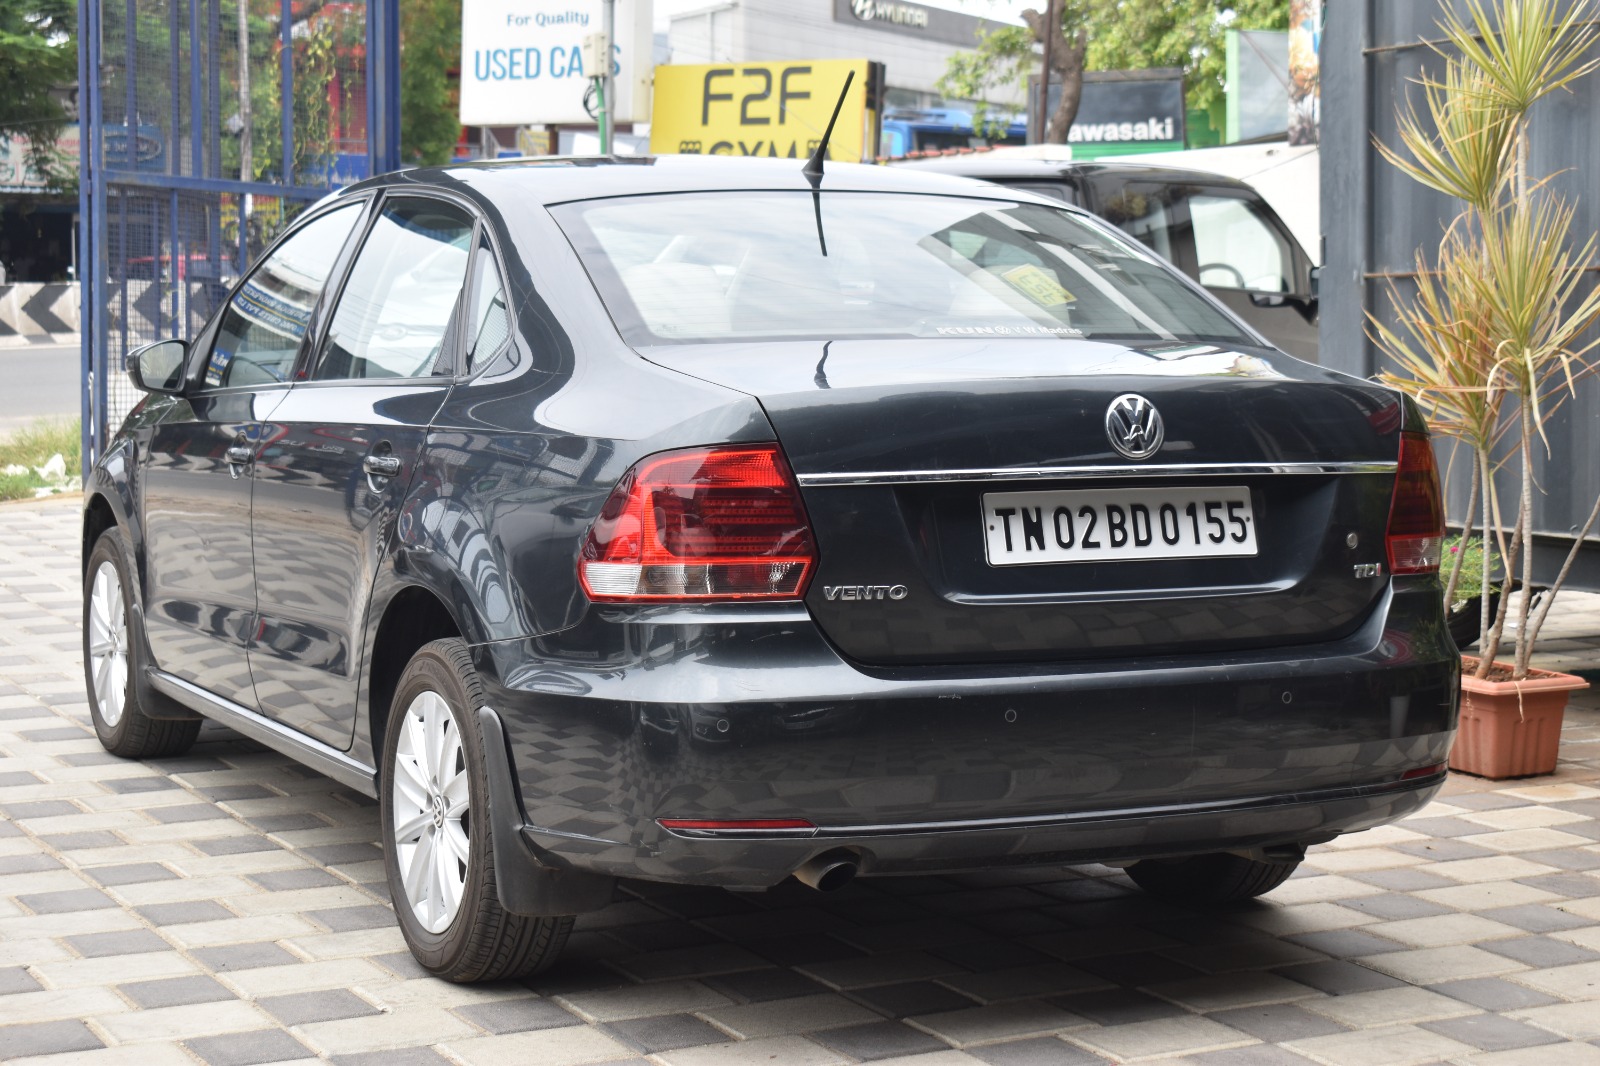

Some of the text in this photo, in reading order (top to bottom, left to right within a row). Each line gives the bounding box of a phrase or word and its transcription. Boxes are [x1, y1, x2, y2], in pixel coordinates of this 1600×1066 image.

[507, 11, 590, 27] For Quality
[875, 2, 929, 28] HYUNDAI
[474, 45, 622, 82] USED CAS
[701, 66, 812, 126] F2F
[1046, 117, 1175, 143] awasaki
[936, 326, 994, 335] KUN
[1038, 326, 1083, 336] Madras
[994, 500, 1248, 552] TN02BD0155
[1353, 562, 1382, 579] TDI
[823, 584, 909, 601] VENTO
